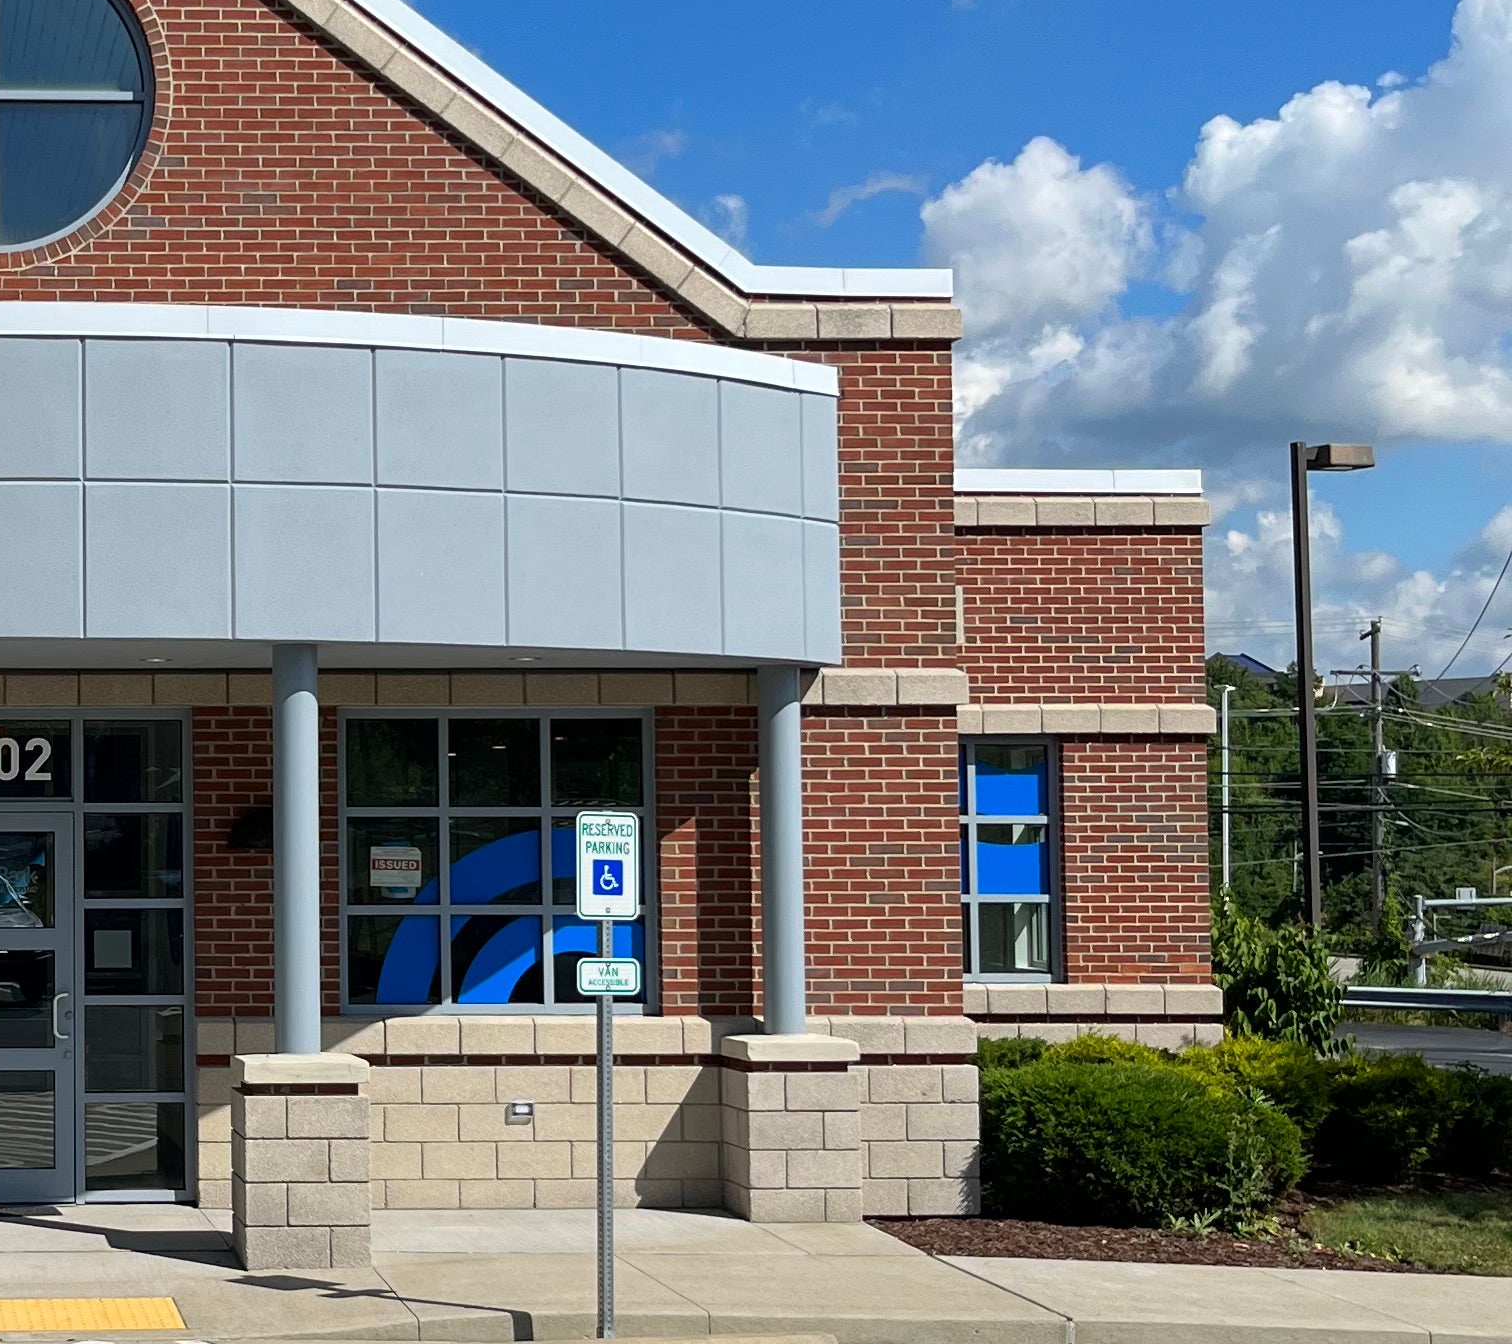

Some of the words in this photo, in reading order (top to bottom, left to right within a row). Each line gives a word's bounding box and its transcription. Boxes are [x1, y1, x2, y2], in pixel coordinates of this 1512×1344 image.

[582, 823, 633, 837] RESERVED
[585, 841, 630, 855] PARKING
[374, 860, 417, 870] ISSUED
[598, 967, 619, 977] VAN
[588, 978, 629, 987] ACCESSIBLE
